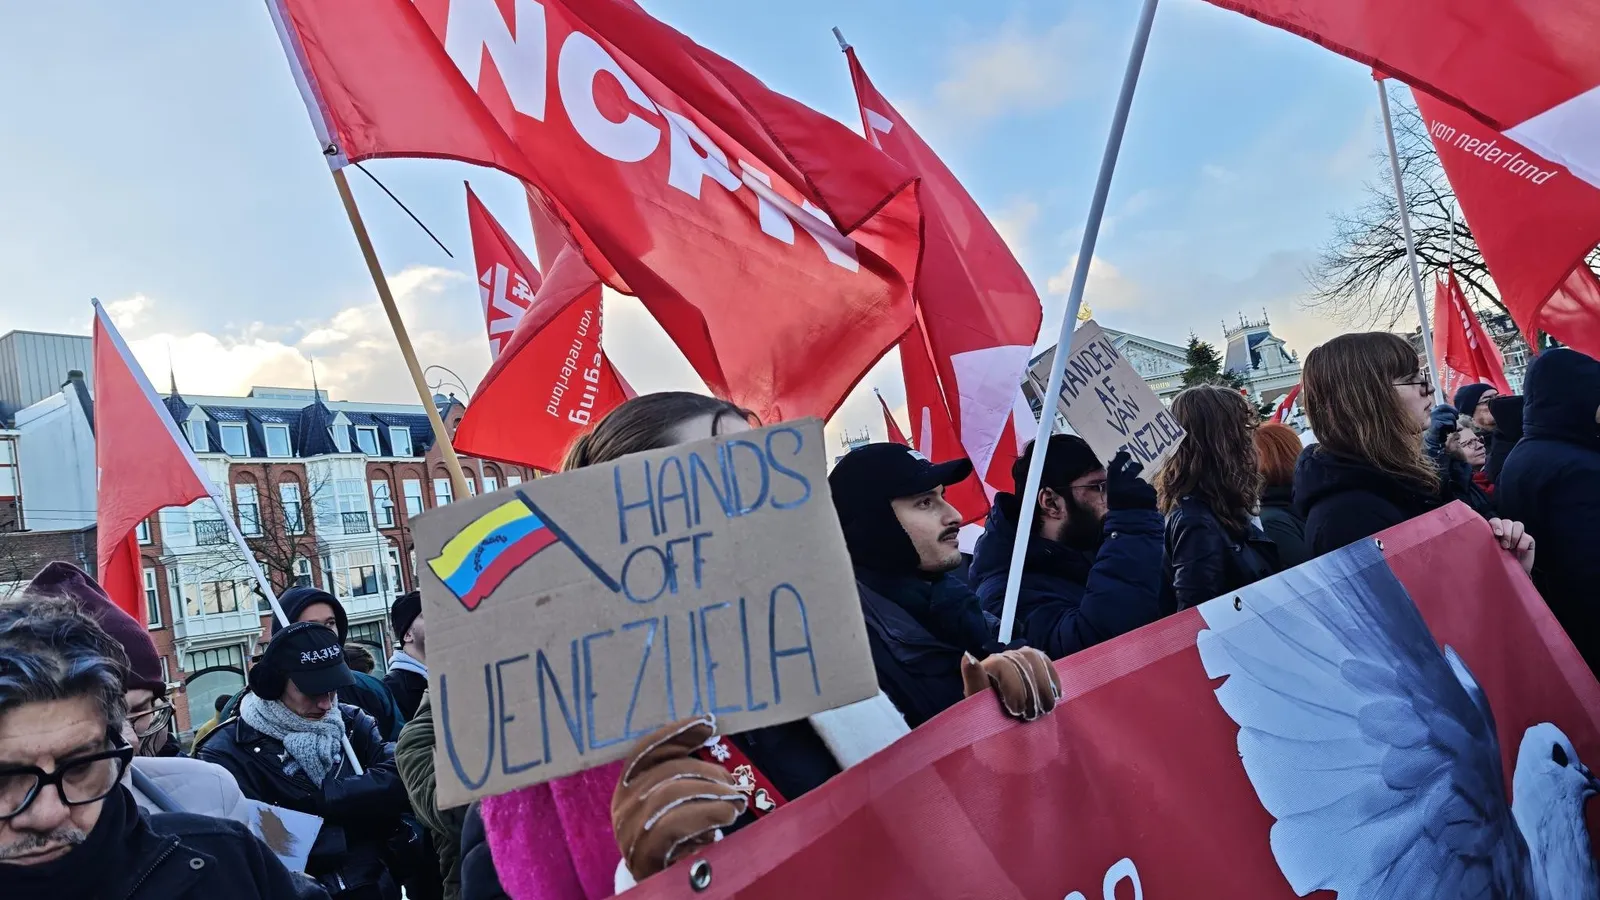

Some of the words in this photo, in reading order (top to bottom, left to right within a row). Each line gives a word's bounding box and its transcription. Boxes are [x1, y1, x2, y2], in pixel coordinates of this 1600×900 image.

[1430, 119, 1455, 142] van
[1453, 130, 1558, 185] nederland
[577, 309, 593, 337] van
[546, 338, 584, 418] nederland
[1094, 375, 1120, 416] AF
[1106, 394, 1141, 437] VAN
[614, 427, 812, 544] HANDS
[621, 532, 714, 603] OFF
